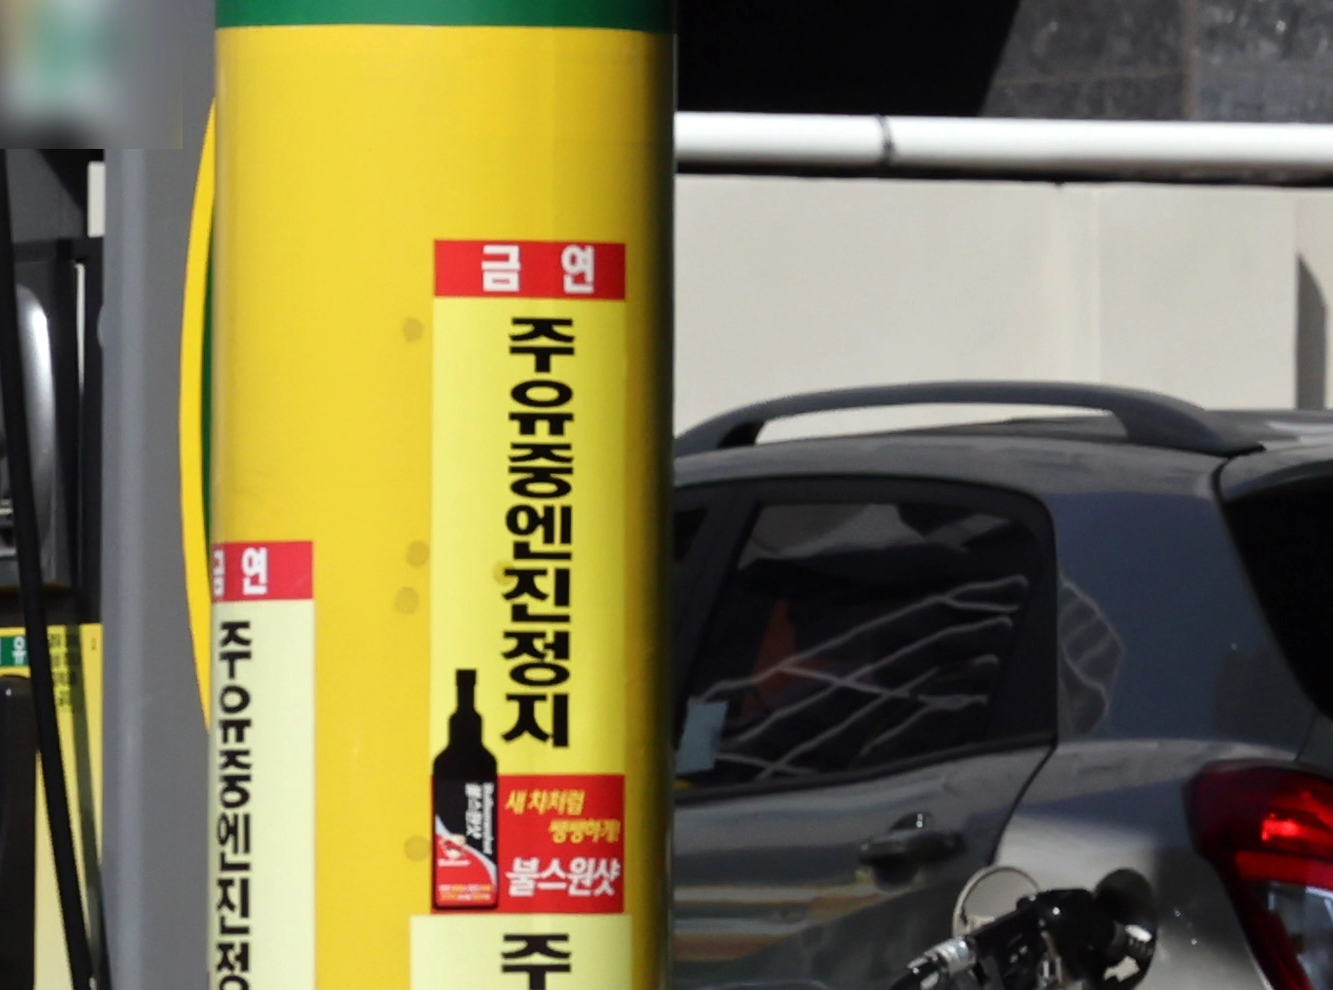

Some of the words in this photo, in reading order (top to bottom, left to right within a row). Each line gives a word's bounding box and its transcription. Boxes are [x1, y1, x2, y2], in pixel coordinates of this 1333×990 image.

[481, 244, 595, 294] 금연
[501, 317, 575, 748] 주유중엔진정지
[505, 857, 621, 897] 불스원샷
